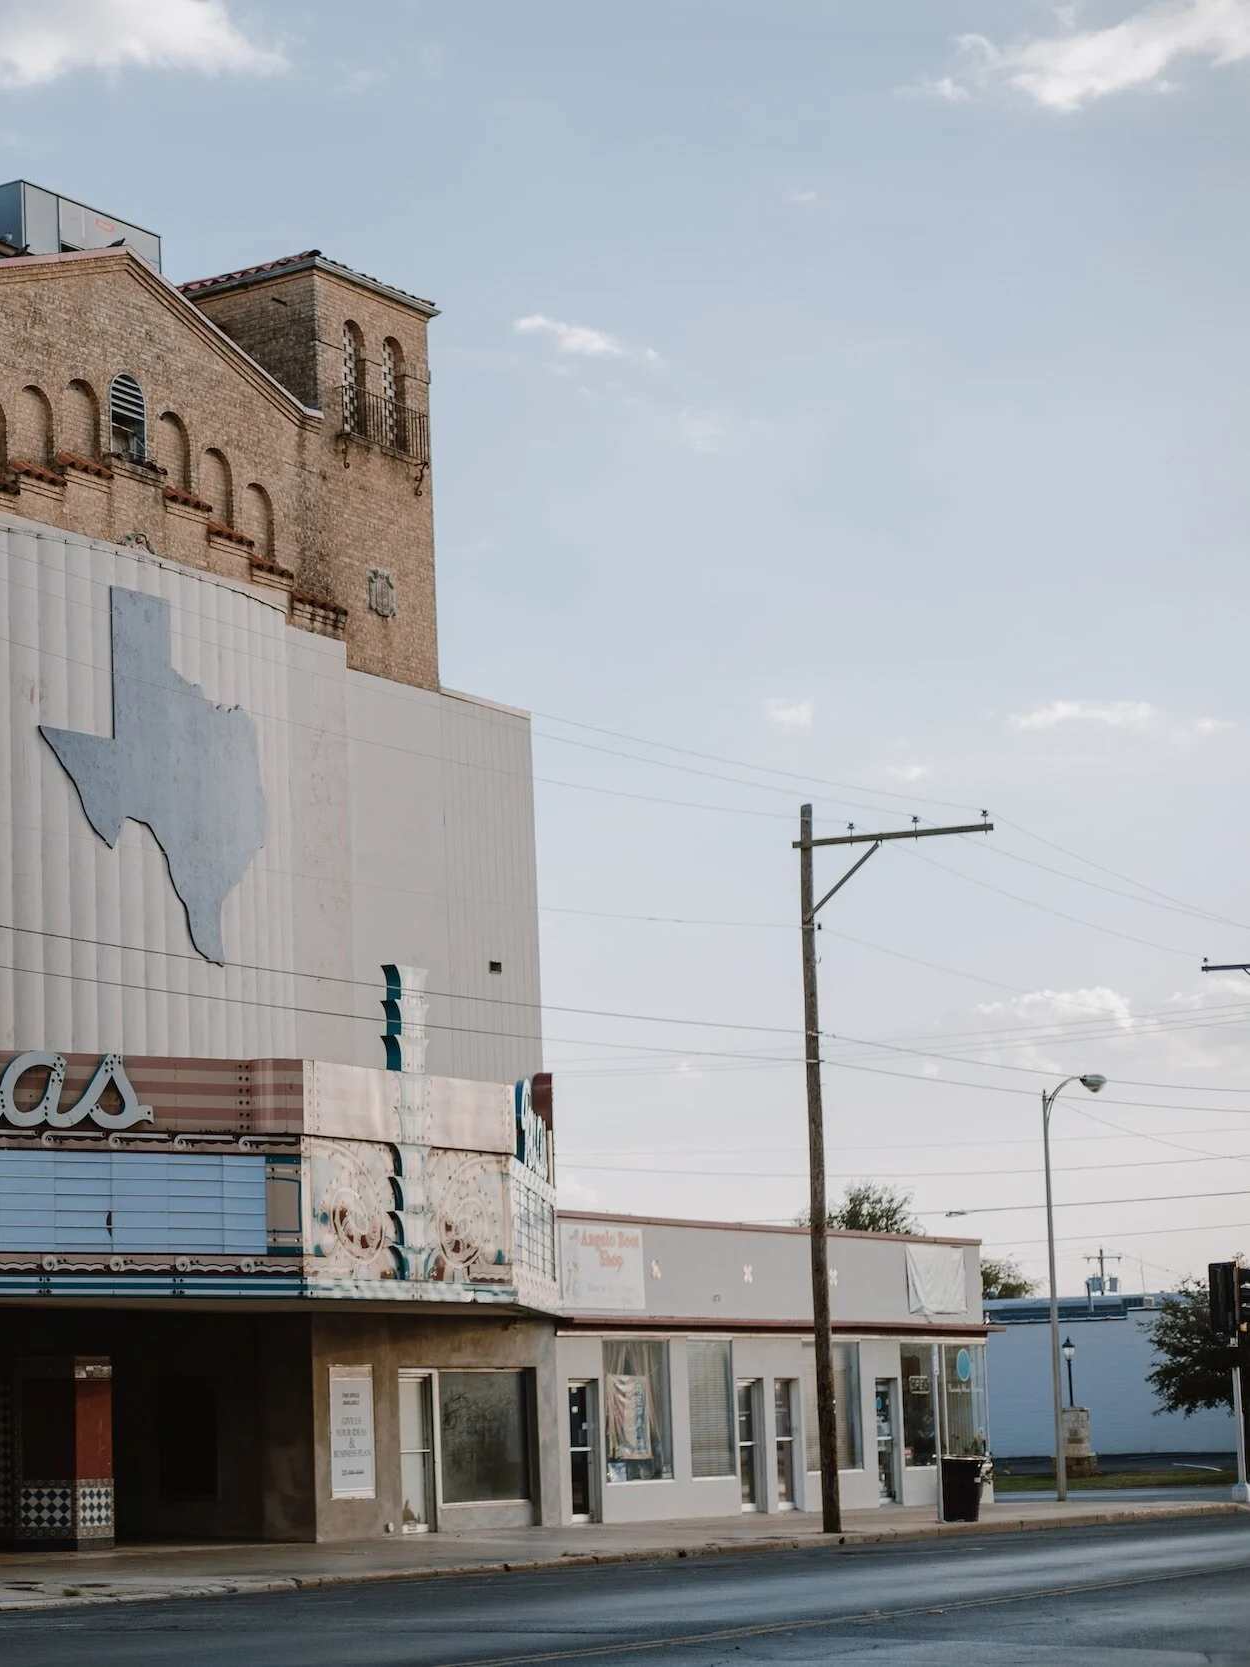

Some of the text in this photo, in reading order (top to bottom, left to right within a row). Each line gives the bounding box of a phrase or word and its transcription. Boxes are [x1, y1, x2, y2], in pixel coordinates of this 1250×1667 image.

[581, 1228, 639, 1252] Angelo Boot
[599, 1250, 624, 1273] Shop
